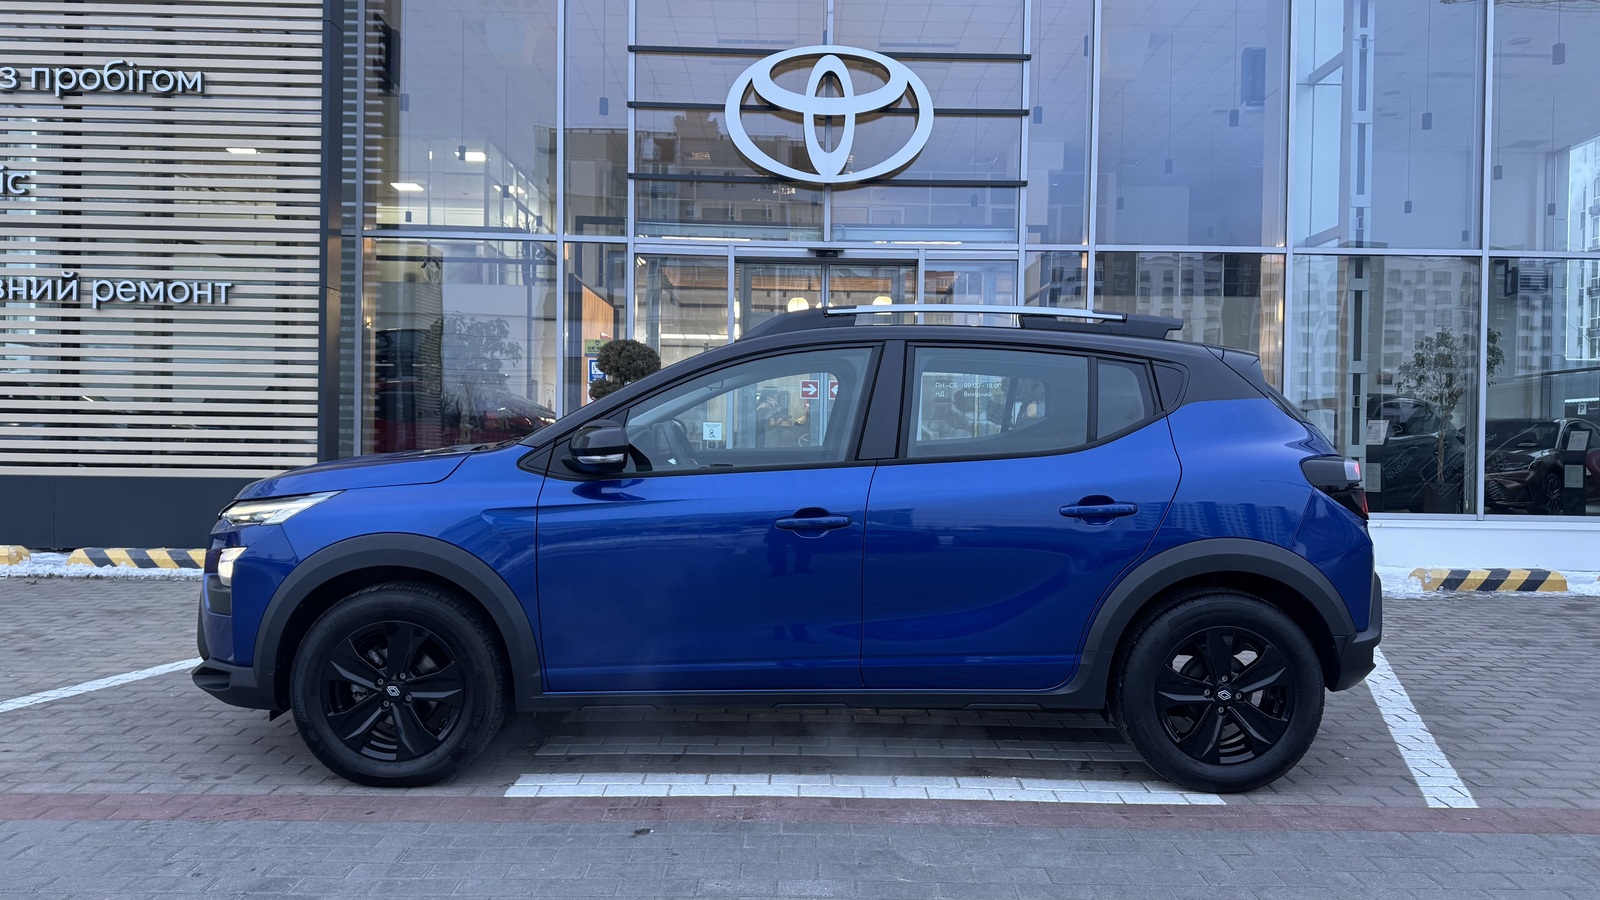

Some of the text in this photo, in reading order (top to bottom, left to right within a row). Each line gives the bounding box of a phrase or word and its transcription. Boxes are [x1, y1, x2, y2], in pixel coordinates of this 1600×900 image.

[0, 59, 203, 97] з пробігом
[0, 271, 232, 309] ний ремонт
